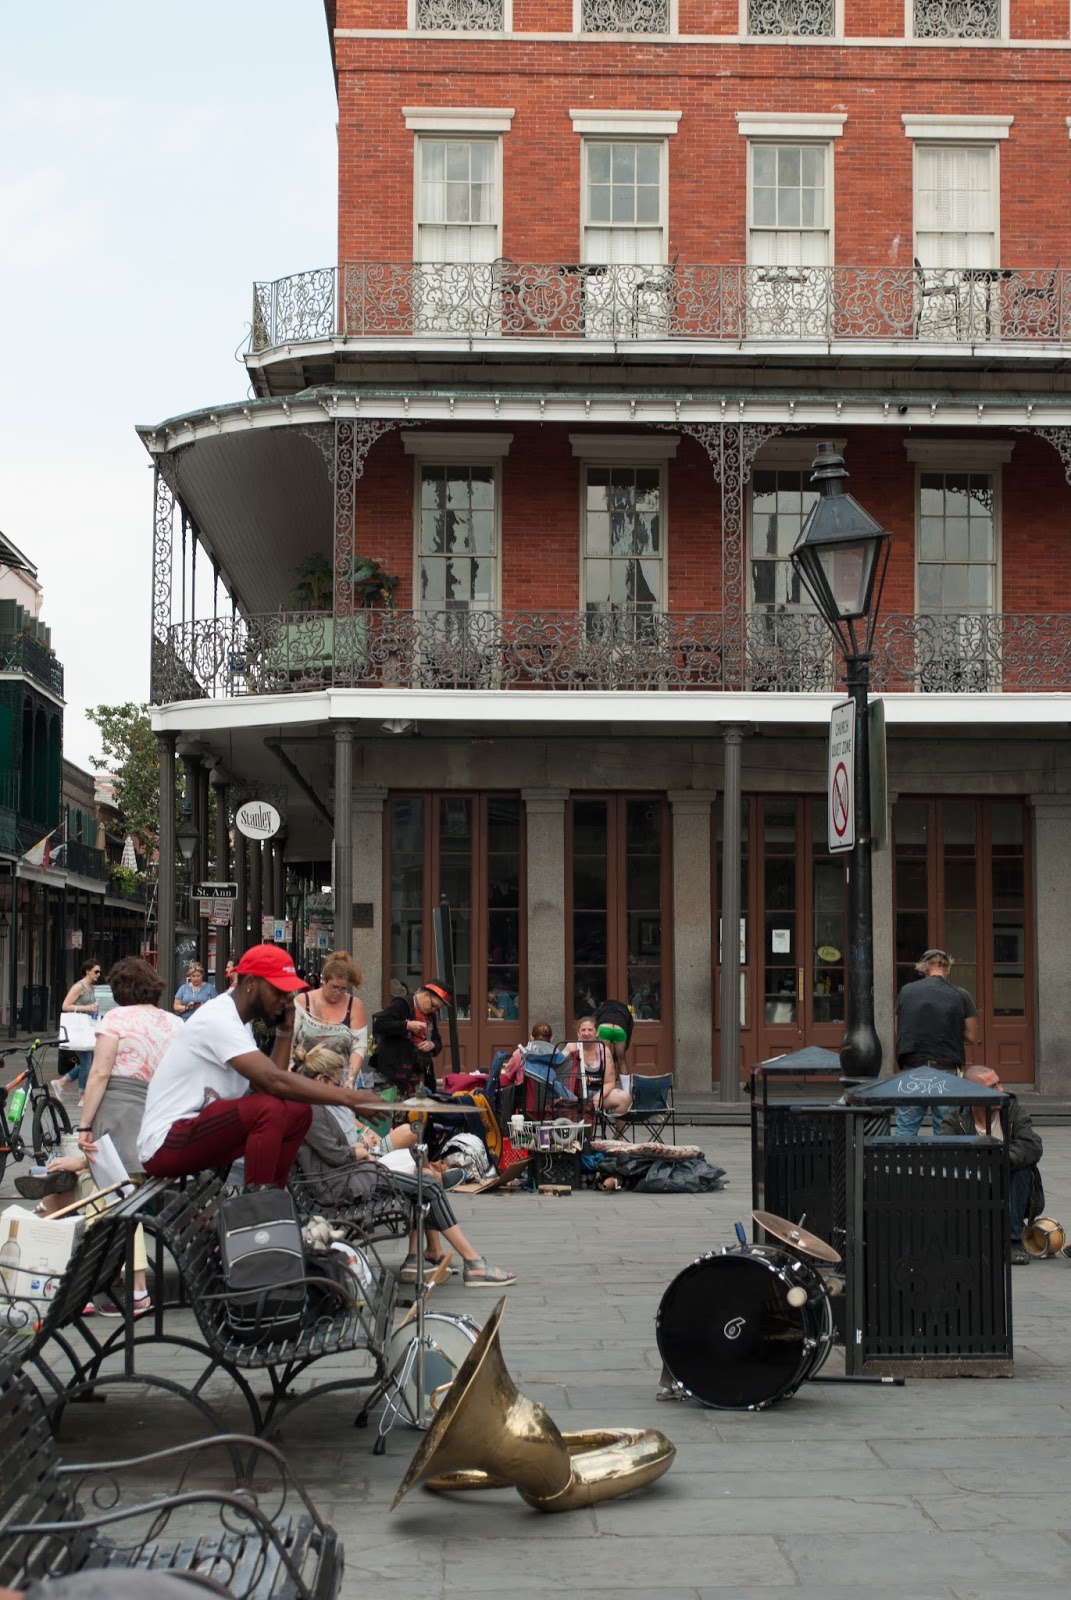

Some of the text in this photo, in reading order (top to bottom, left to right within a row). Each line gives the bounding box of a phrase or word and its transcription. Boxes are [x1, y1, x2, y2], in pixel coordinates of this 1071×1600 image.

[835, 719, 849, 737] CHURCH
[831, 738, 852, 758] QUIET ZONE
[196, 888, 232, 897] St. Ann
